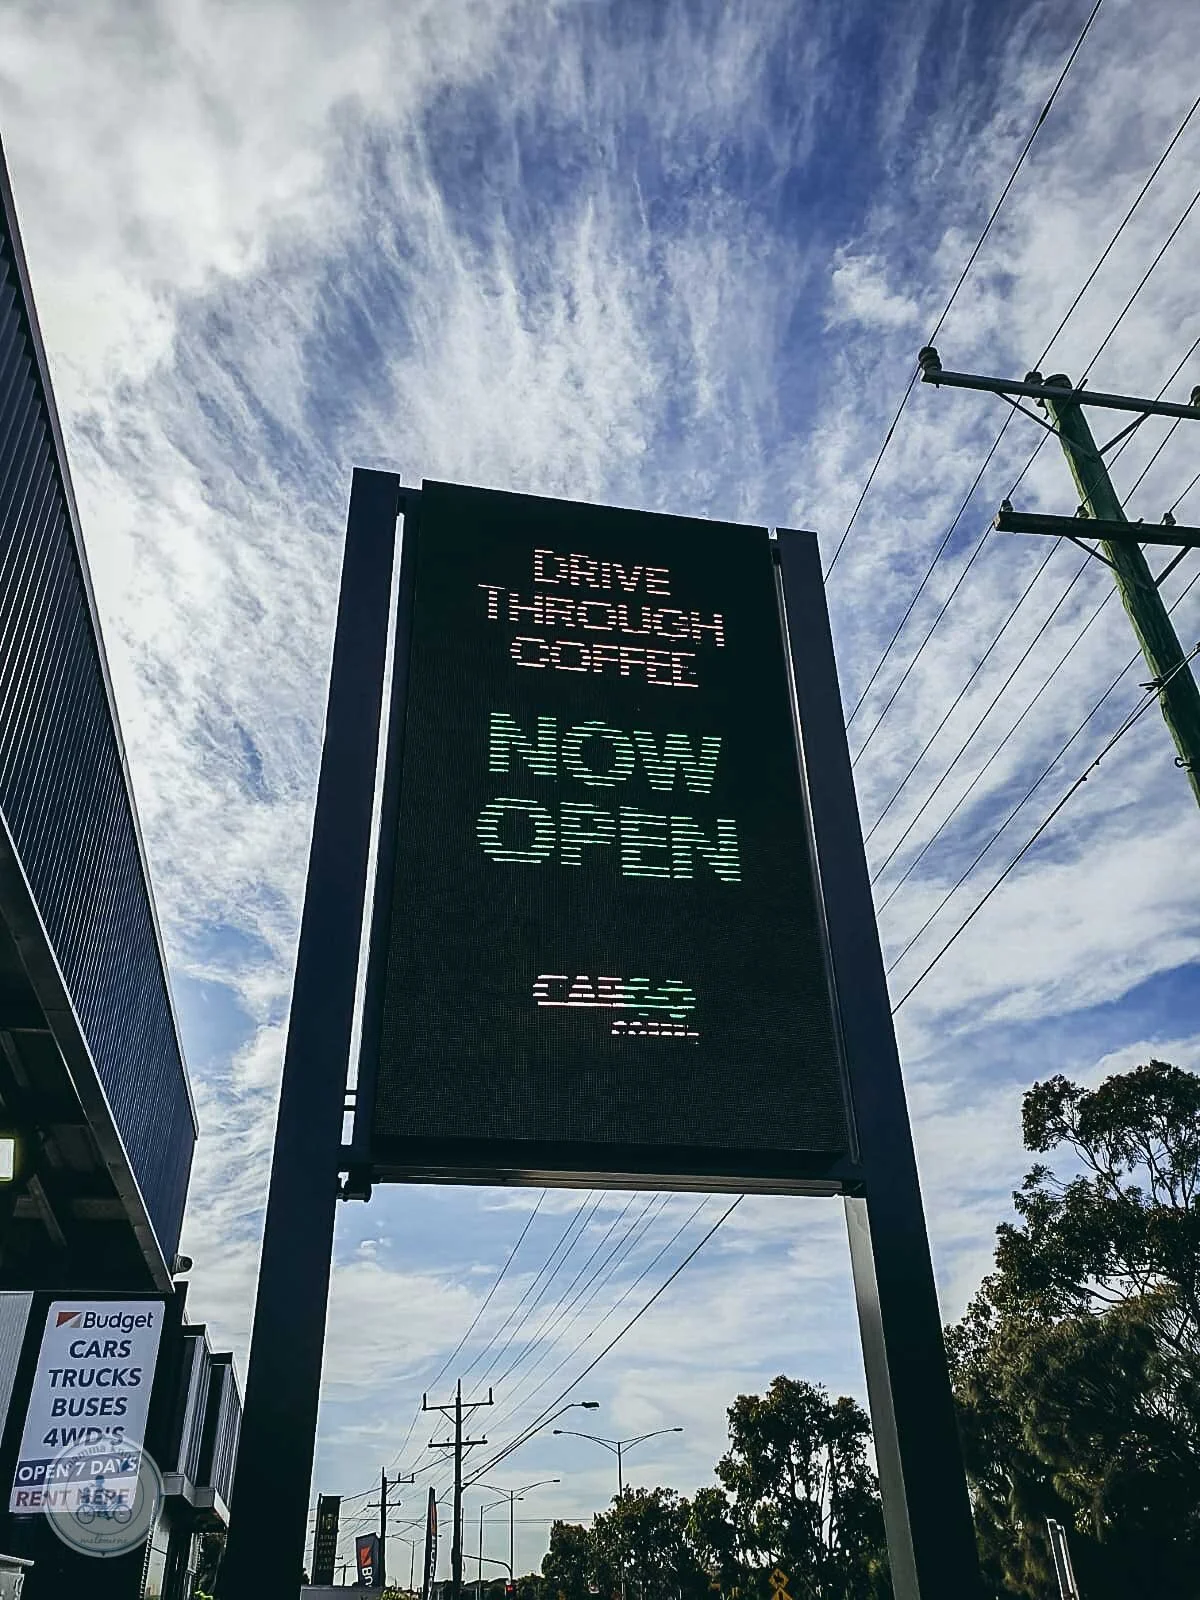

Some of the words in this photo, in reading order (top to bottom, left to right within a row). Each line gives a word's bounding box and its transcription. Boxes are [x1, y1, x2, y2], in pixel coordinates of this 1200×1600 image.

[534, 549, 671, 596] DRIVE
[477, 583, 726, 648] THROUGH
[508, 636, 700, 689] COFFEE
[488, 712, 723, 794] NOW
[475, 798, 742, 882] OPEN
[83, 1311, 154, 1333] Budget
[69, 1340, 132, 1359] CARS
[48, 1367, 142, 1388] TRUCKS
[51, 1396, 128, 1417] BUSES
[43, 1426, 126, 1447] 4WD'S
[18, 1462, 69, 1481] OPEN
[75, 1462, 86, 1475] 7
[90, 1456, 137, 1475] DAYS
[15, 1489, 71, 1507] RENT
